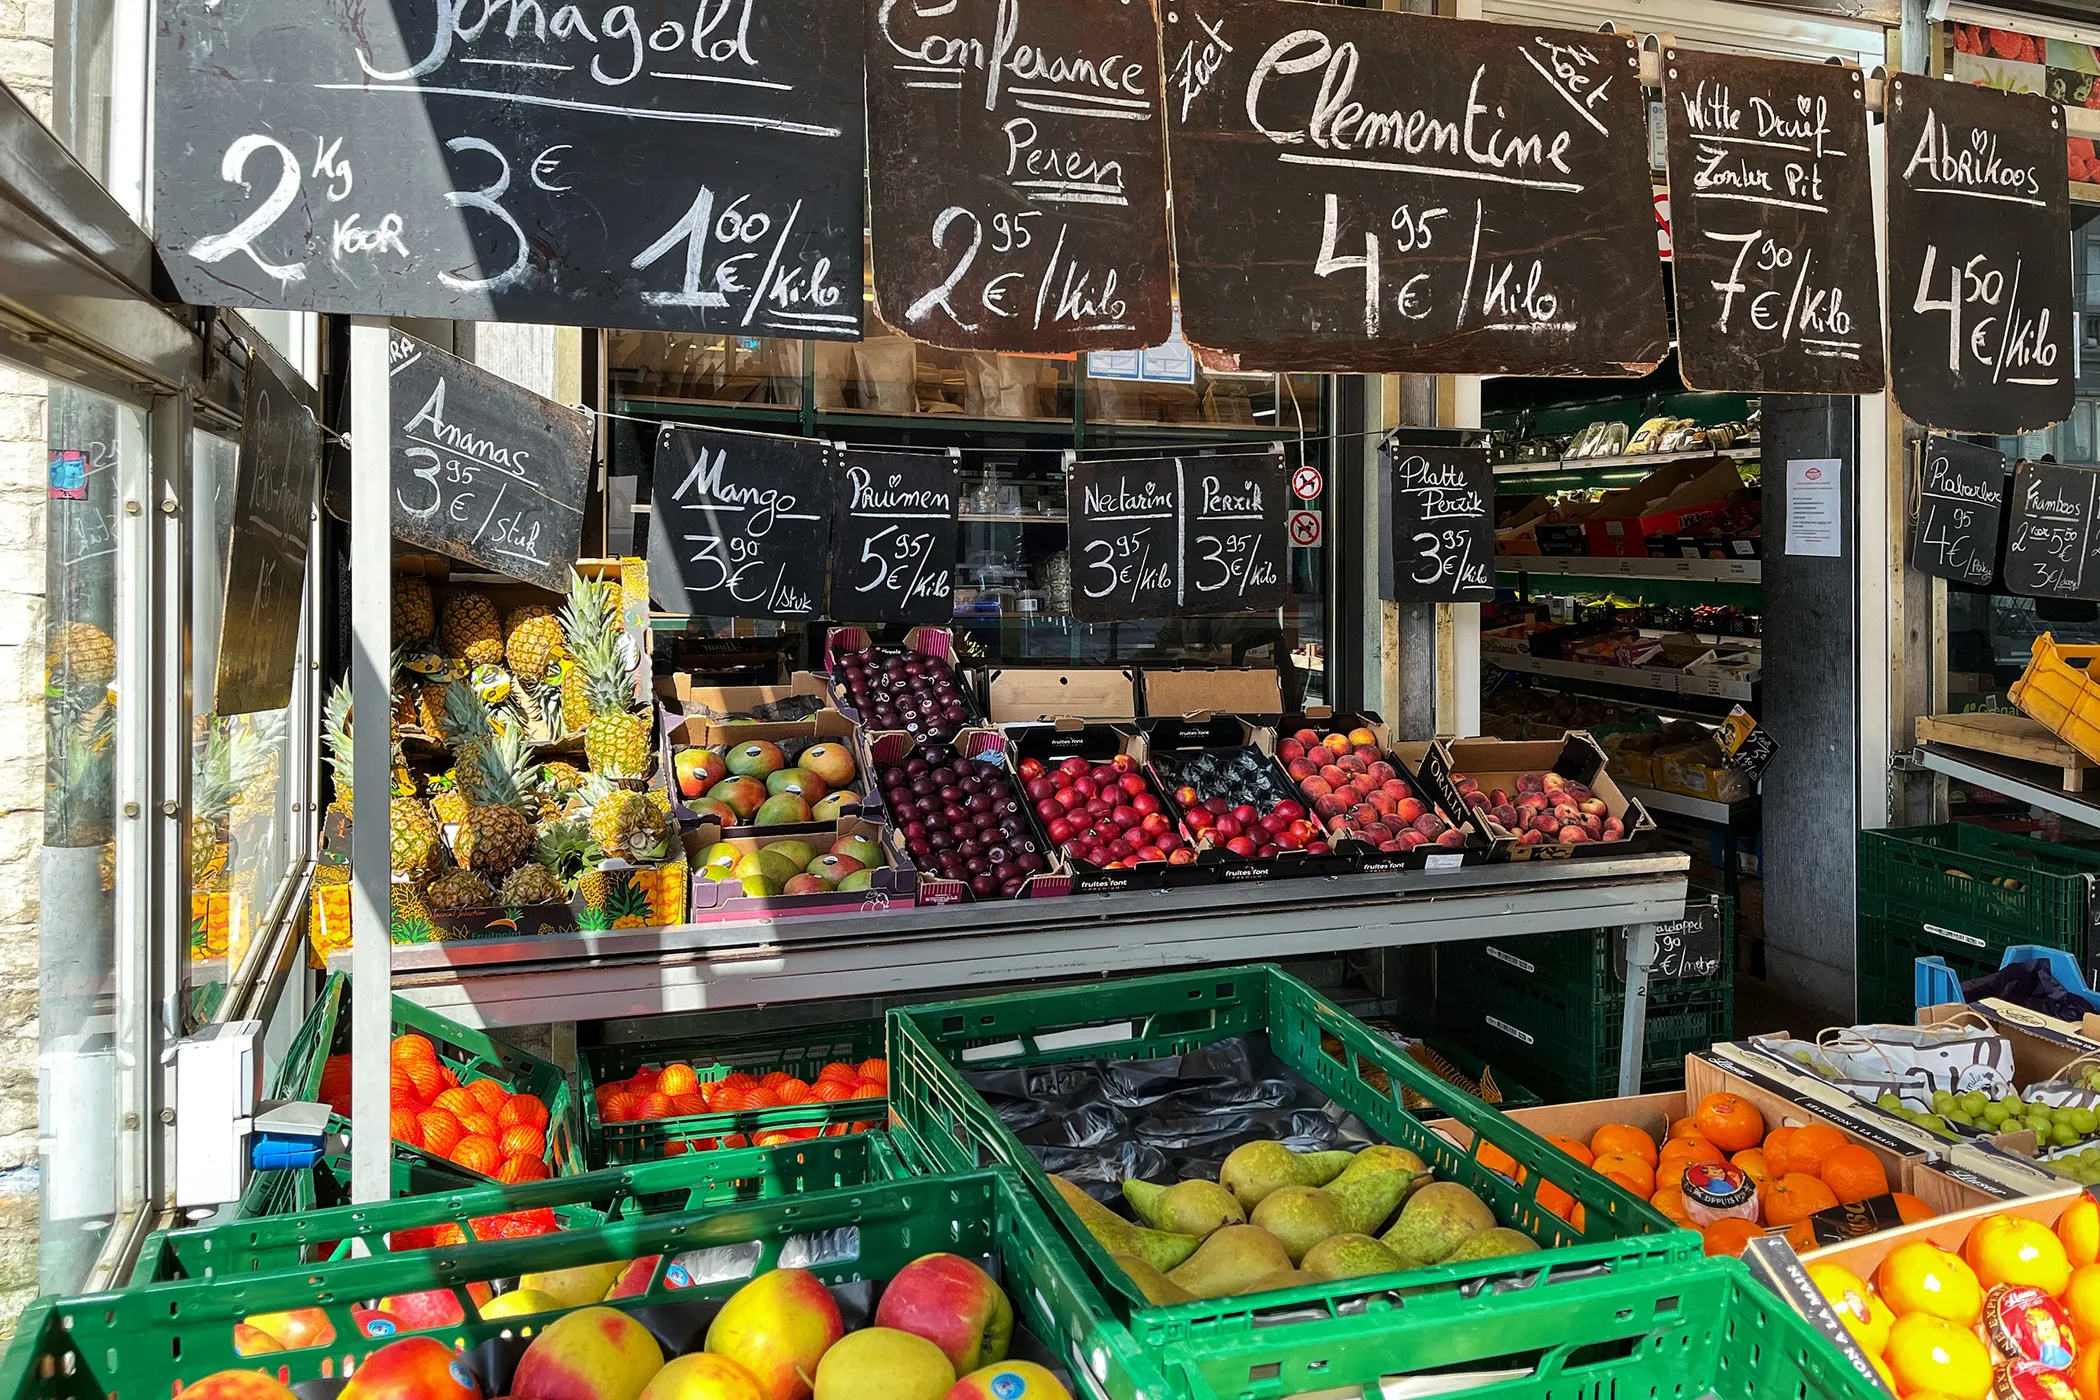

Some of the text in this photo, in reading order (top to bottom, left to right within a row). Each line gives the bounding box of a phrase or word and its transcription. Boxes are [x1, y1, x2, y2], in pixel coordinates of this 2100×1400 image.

[1245, 28, 1571, 174] Clementine
[1681, 76, 1832, 158] Witte Druif
[188, 134, 306, 283] 2
[1785, 163, 1824, 201] Pit
[403, 376, 530, 477] Ananas
[1399, 455, 1469, 489] Platte
[671, 446, 797, 538] Mango
